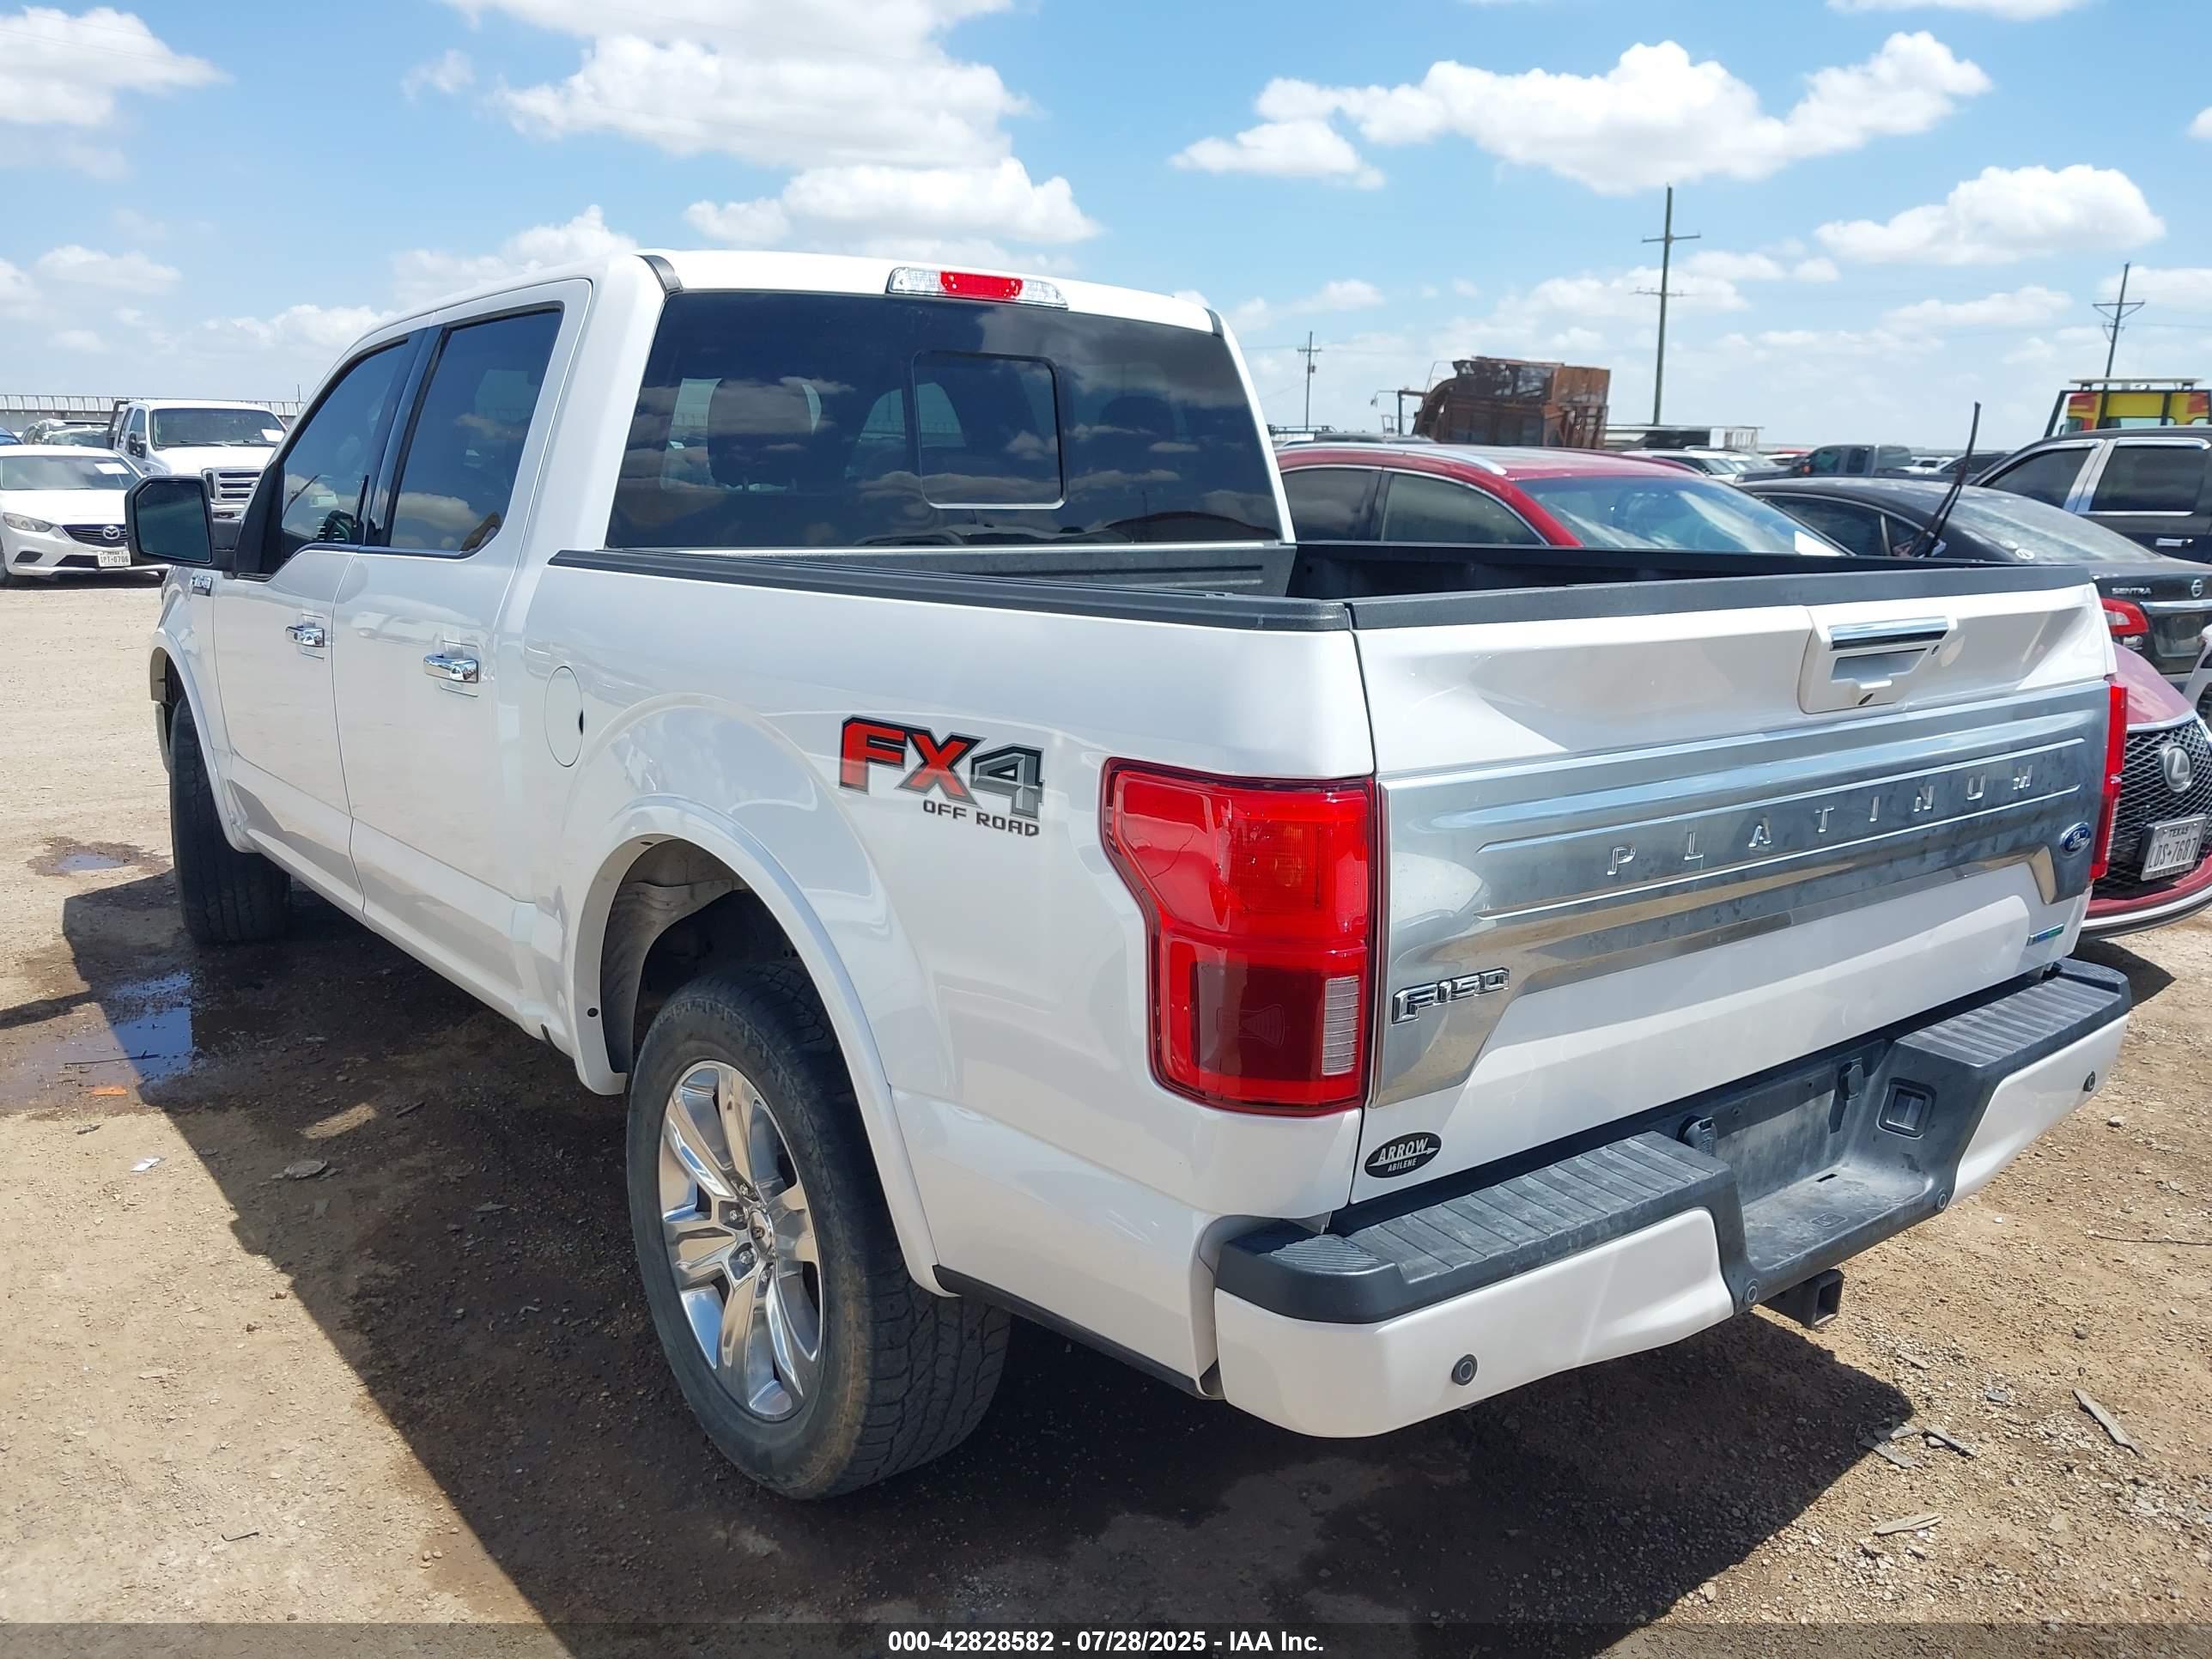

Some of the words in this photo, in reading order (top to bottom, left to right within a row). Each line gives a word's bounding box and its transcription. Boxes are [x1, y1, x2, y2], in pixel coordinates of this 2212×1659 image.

[2111, 586, 2153, 596] SENTRA
[838, 714, 1046, 822] FX4
[922, 799, 968, 820] OFF
[975, 810, 1040, 837] ROAD
[1607, 764, 2033, 876] PLATINUM
[2169, 825, 2190, 838] TEXAS
[1377, 1137, 1430, 1163] ARROW
[1387, 1158, 1418, 1173] ABILENE
